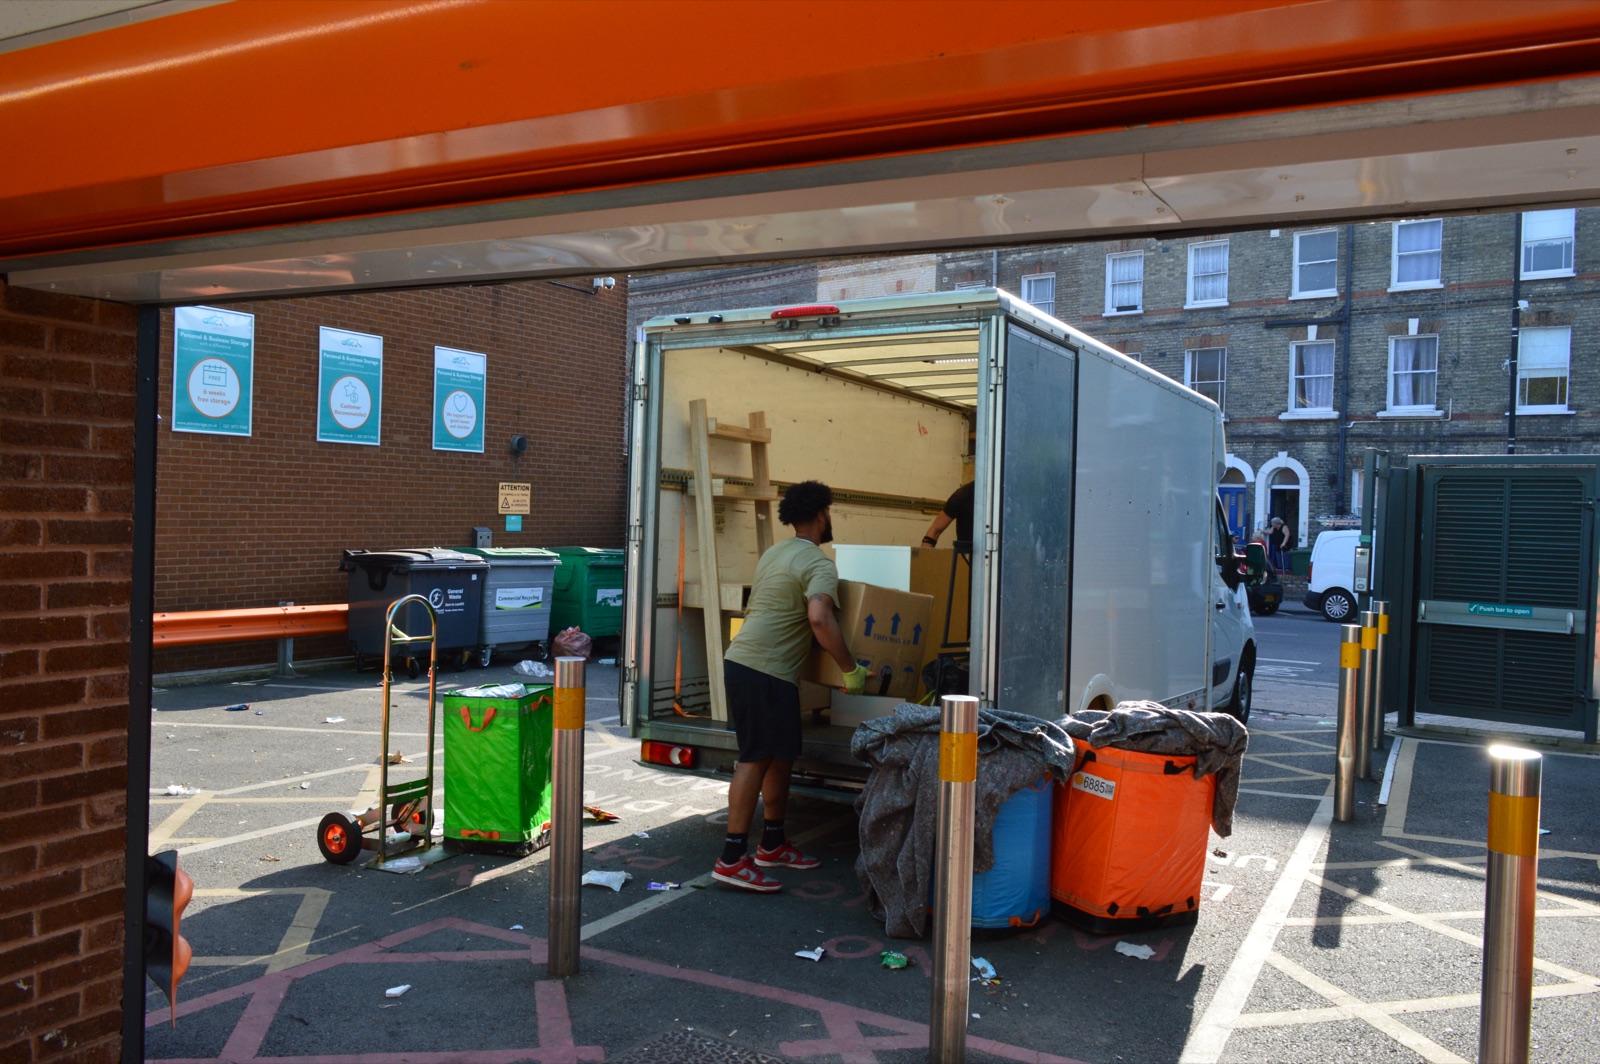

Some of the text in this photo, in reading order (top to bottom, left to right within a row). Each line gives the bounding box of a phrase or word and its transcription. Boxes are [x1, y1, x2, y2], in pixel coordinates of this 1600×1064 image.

[180, 332, 202, 341] Personal
[209, 335, 230, 344] Business
[230, 338, 249, 347] Storage
[210, 398, 231, 406] storage
[1083, 776, 1105, 793] 6885
